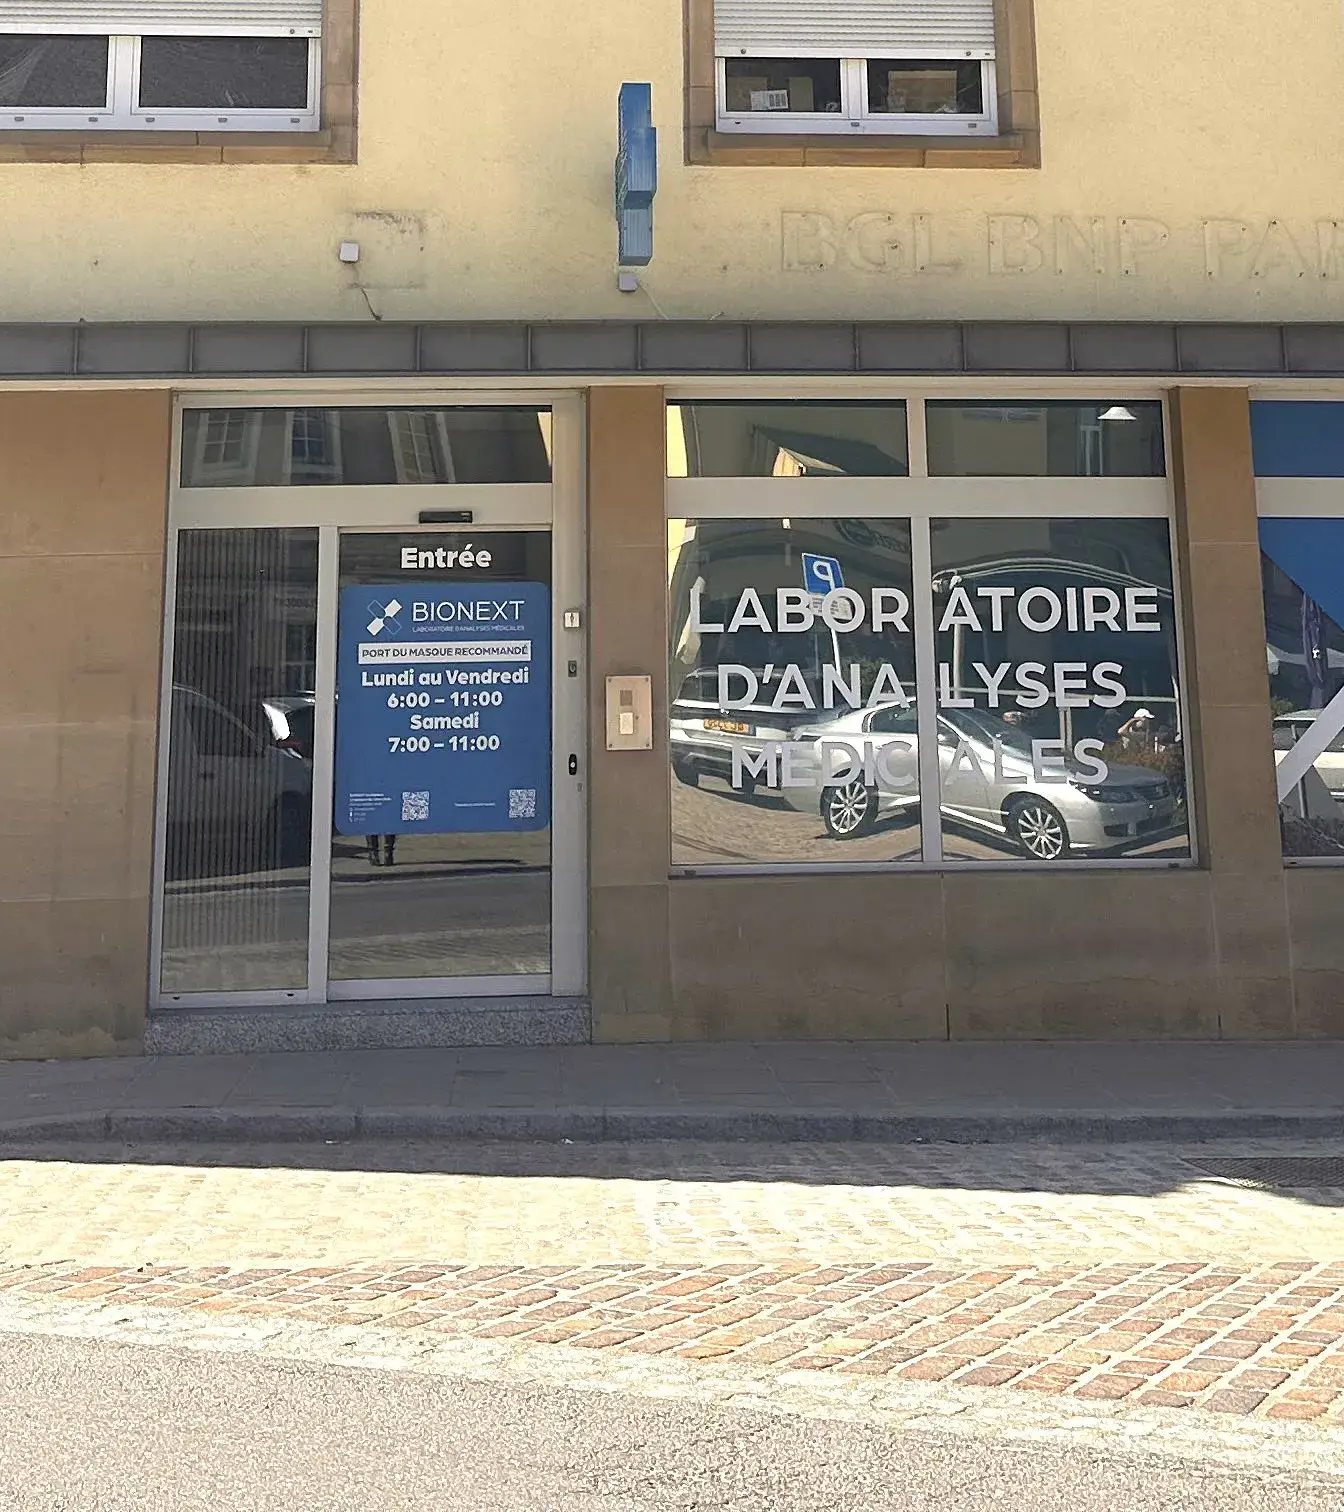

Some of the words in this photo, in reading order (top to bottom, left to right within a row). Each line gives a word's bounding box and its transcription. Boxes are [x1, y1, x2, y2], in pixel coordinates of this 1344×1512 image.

[780, 210, 963, 273] BGL
[986, 213, 1172, 276] BNP
[400, 543, 493, 569] Entrée
[412, 600, 525, 622] BIONEXT
[362, 648, 391, 658] PORT
[392, 648, 407, 657] DU
[408, 647, 454, 657] MASQUE
[455, 645, 529, 656] RECOMMANDÉ
[361, 668, 415, 687] Lundi
[418, 672, 442, 686] au
[445, 666, 529, 685] Vendredi
[387, 692, 430, 708] 6:00
[450, 691, 503, 707] 11:00
[410, 711, 479, 730] Samedi
[388, 736, 430, 753] 7:00
[449, 735, 500, 751] 11:00
